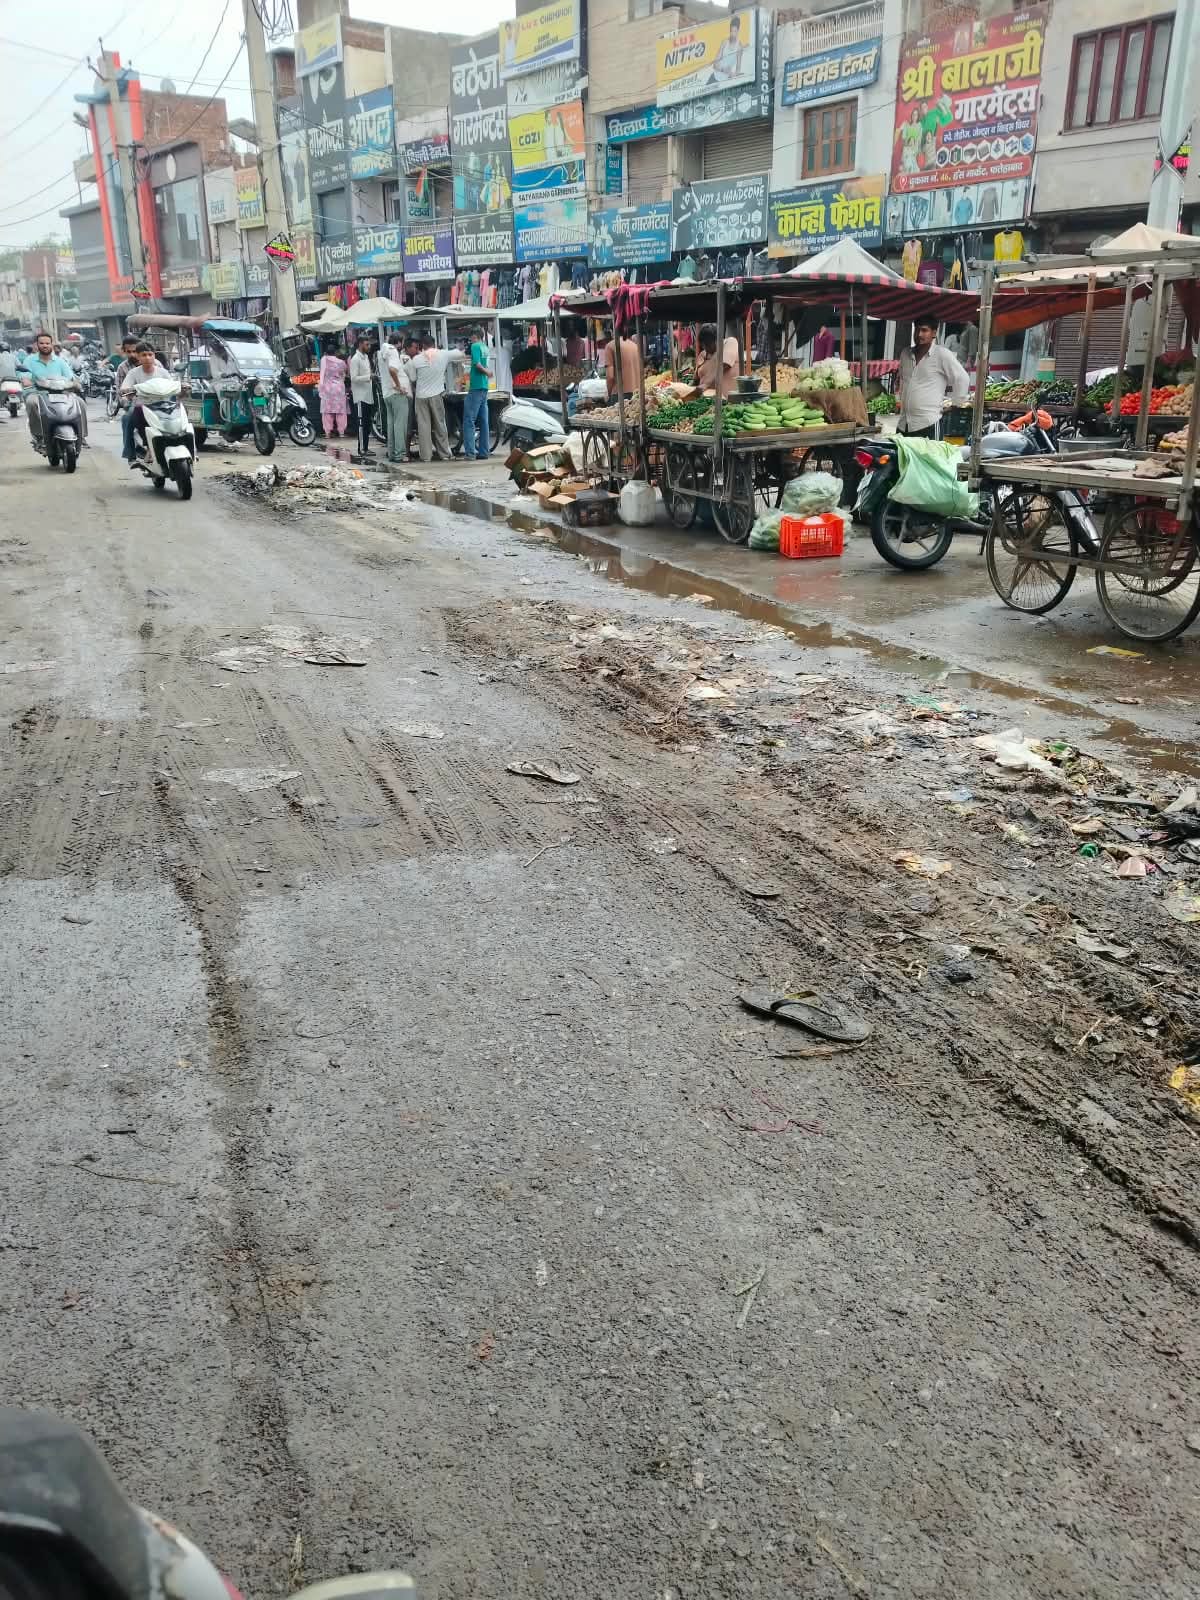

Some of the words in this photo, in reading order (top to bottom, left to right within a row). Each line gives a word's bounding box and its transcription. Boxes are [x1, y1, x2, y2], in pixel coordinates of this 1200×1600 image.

[759, 25, 771, 116] HANDSOME
[901, 55, 937, 101] श्री
[941, 29, 1043, 92] बालाजी
[518, 131, 541, 146] COZI
[777, 203, 826, 237] कान्हा
[829, 192, 881, 231] फैशन
